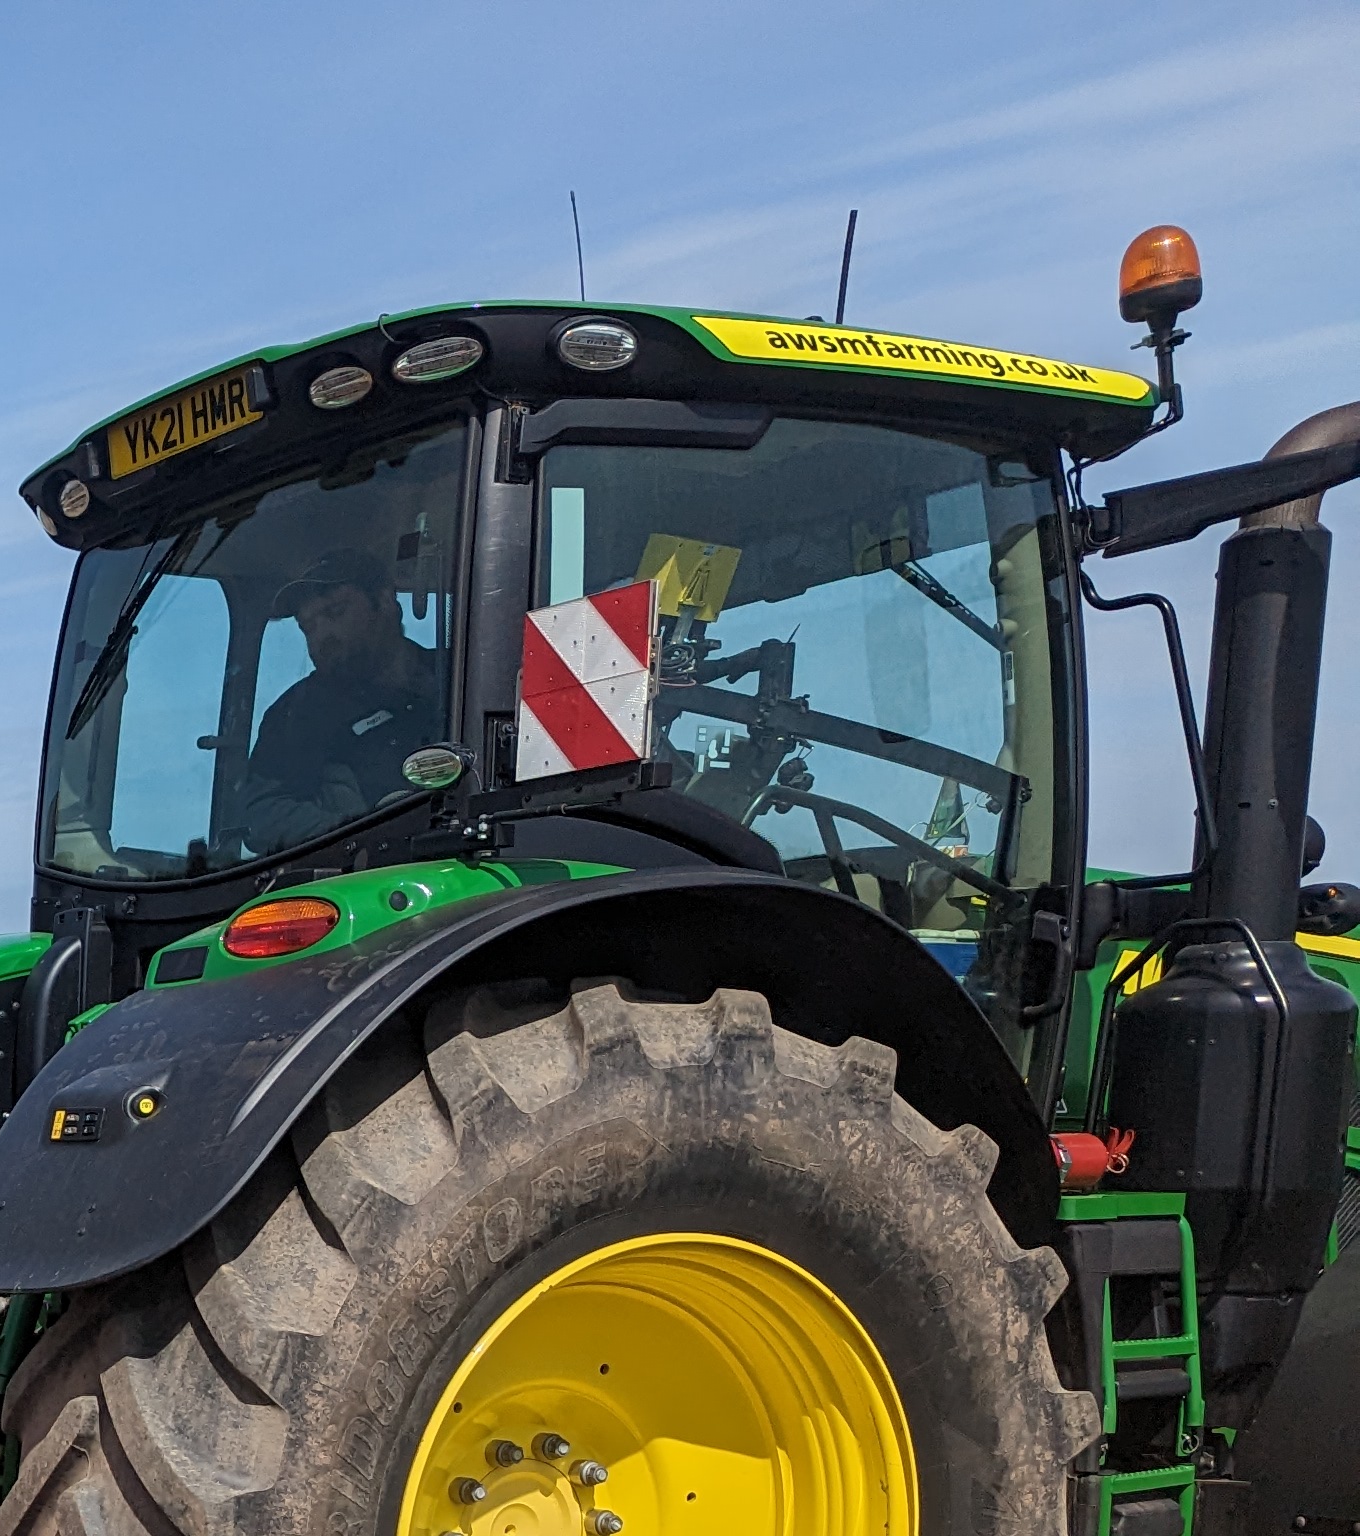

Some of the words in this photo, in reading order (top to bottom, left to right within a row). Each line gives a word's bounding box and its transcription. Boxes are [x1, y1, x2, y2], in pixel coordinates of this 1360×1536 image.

[764, 328, 1099, 385] awsmfarming.co.uk
[124, 403, 185, 464] YK21
[191, 377, 246, 439] HMR
